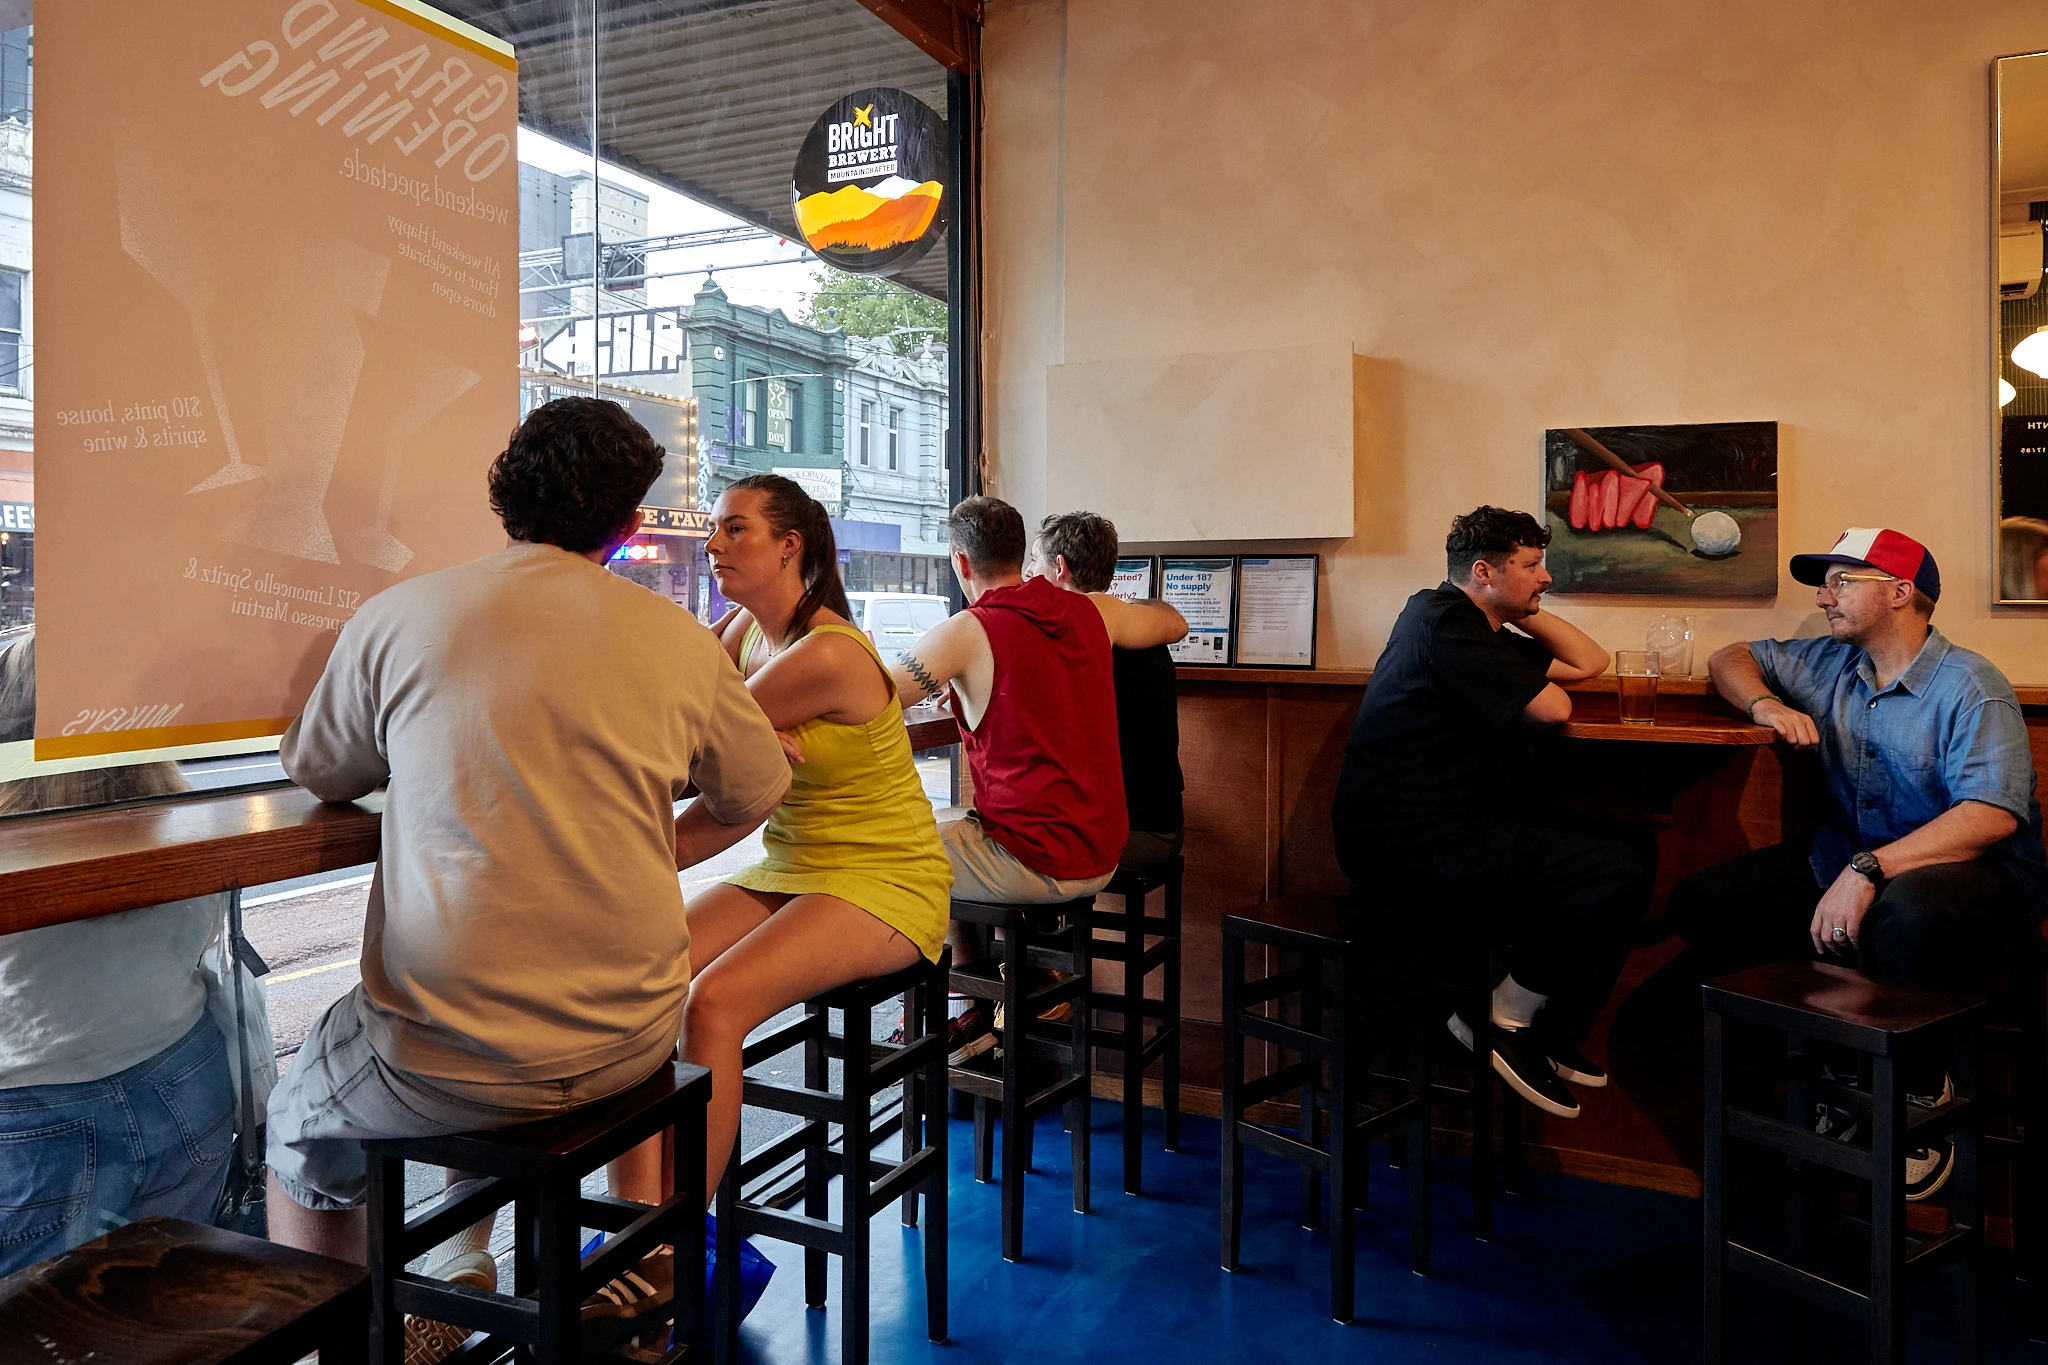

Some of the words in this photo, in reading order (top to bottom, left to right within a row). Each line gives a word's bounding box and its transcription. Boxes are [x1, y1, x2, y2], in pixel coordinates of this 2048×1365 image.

[828, 112, 899, 153] BRIGHT
[828, 144, 898, 168] BREWERY
[830, 163, 895, 179] MOUNTAINCRAFTED
[767, 407, 785, 420] OPEN
[774, 421, 779, 431] 7
[768, 432, 785, 443] DAYS
[668, 511, 709, 528] TAV
[1166, 573, 1194, 581] Under
[1197, 573, 1213, 581] 18?
